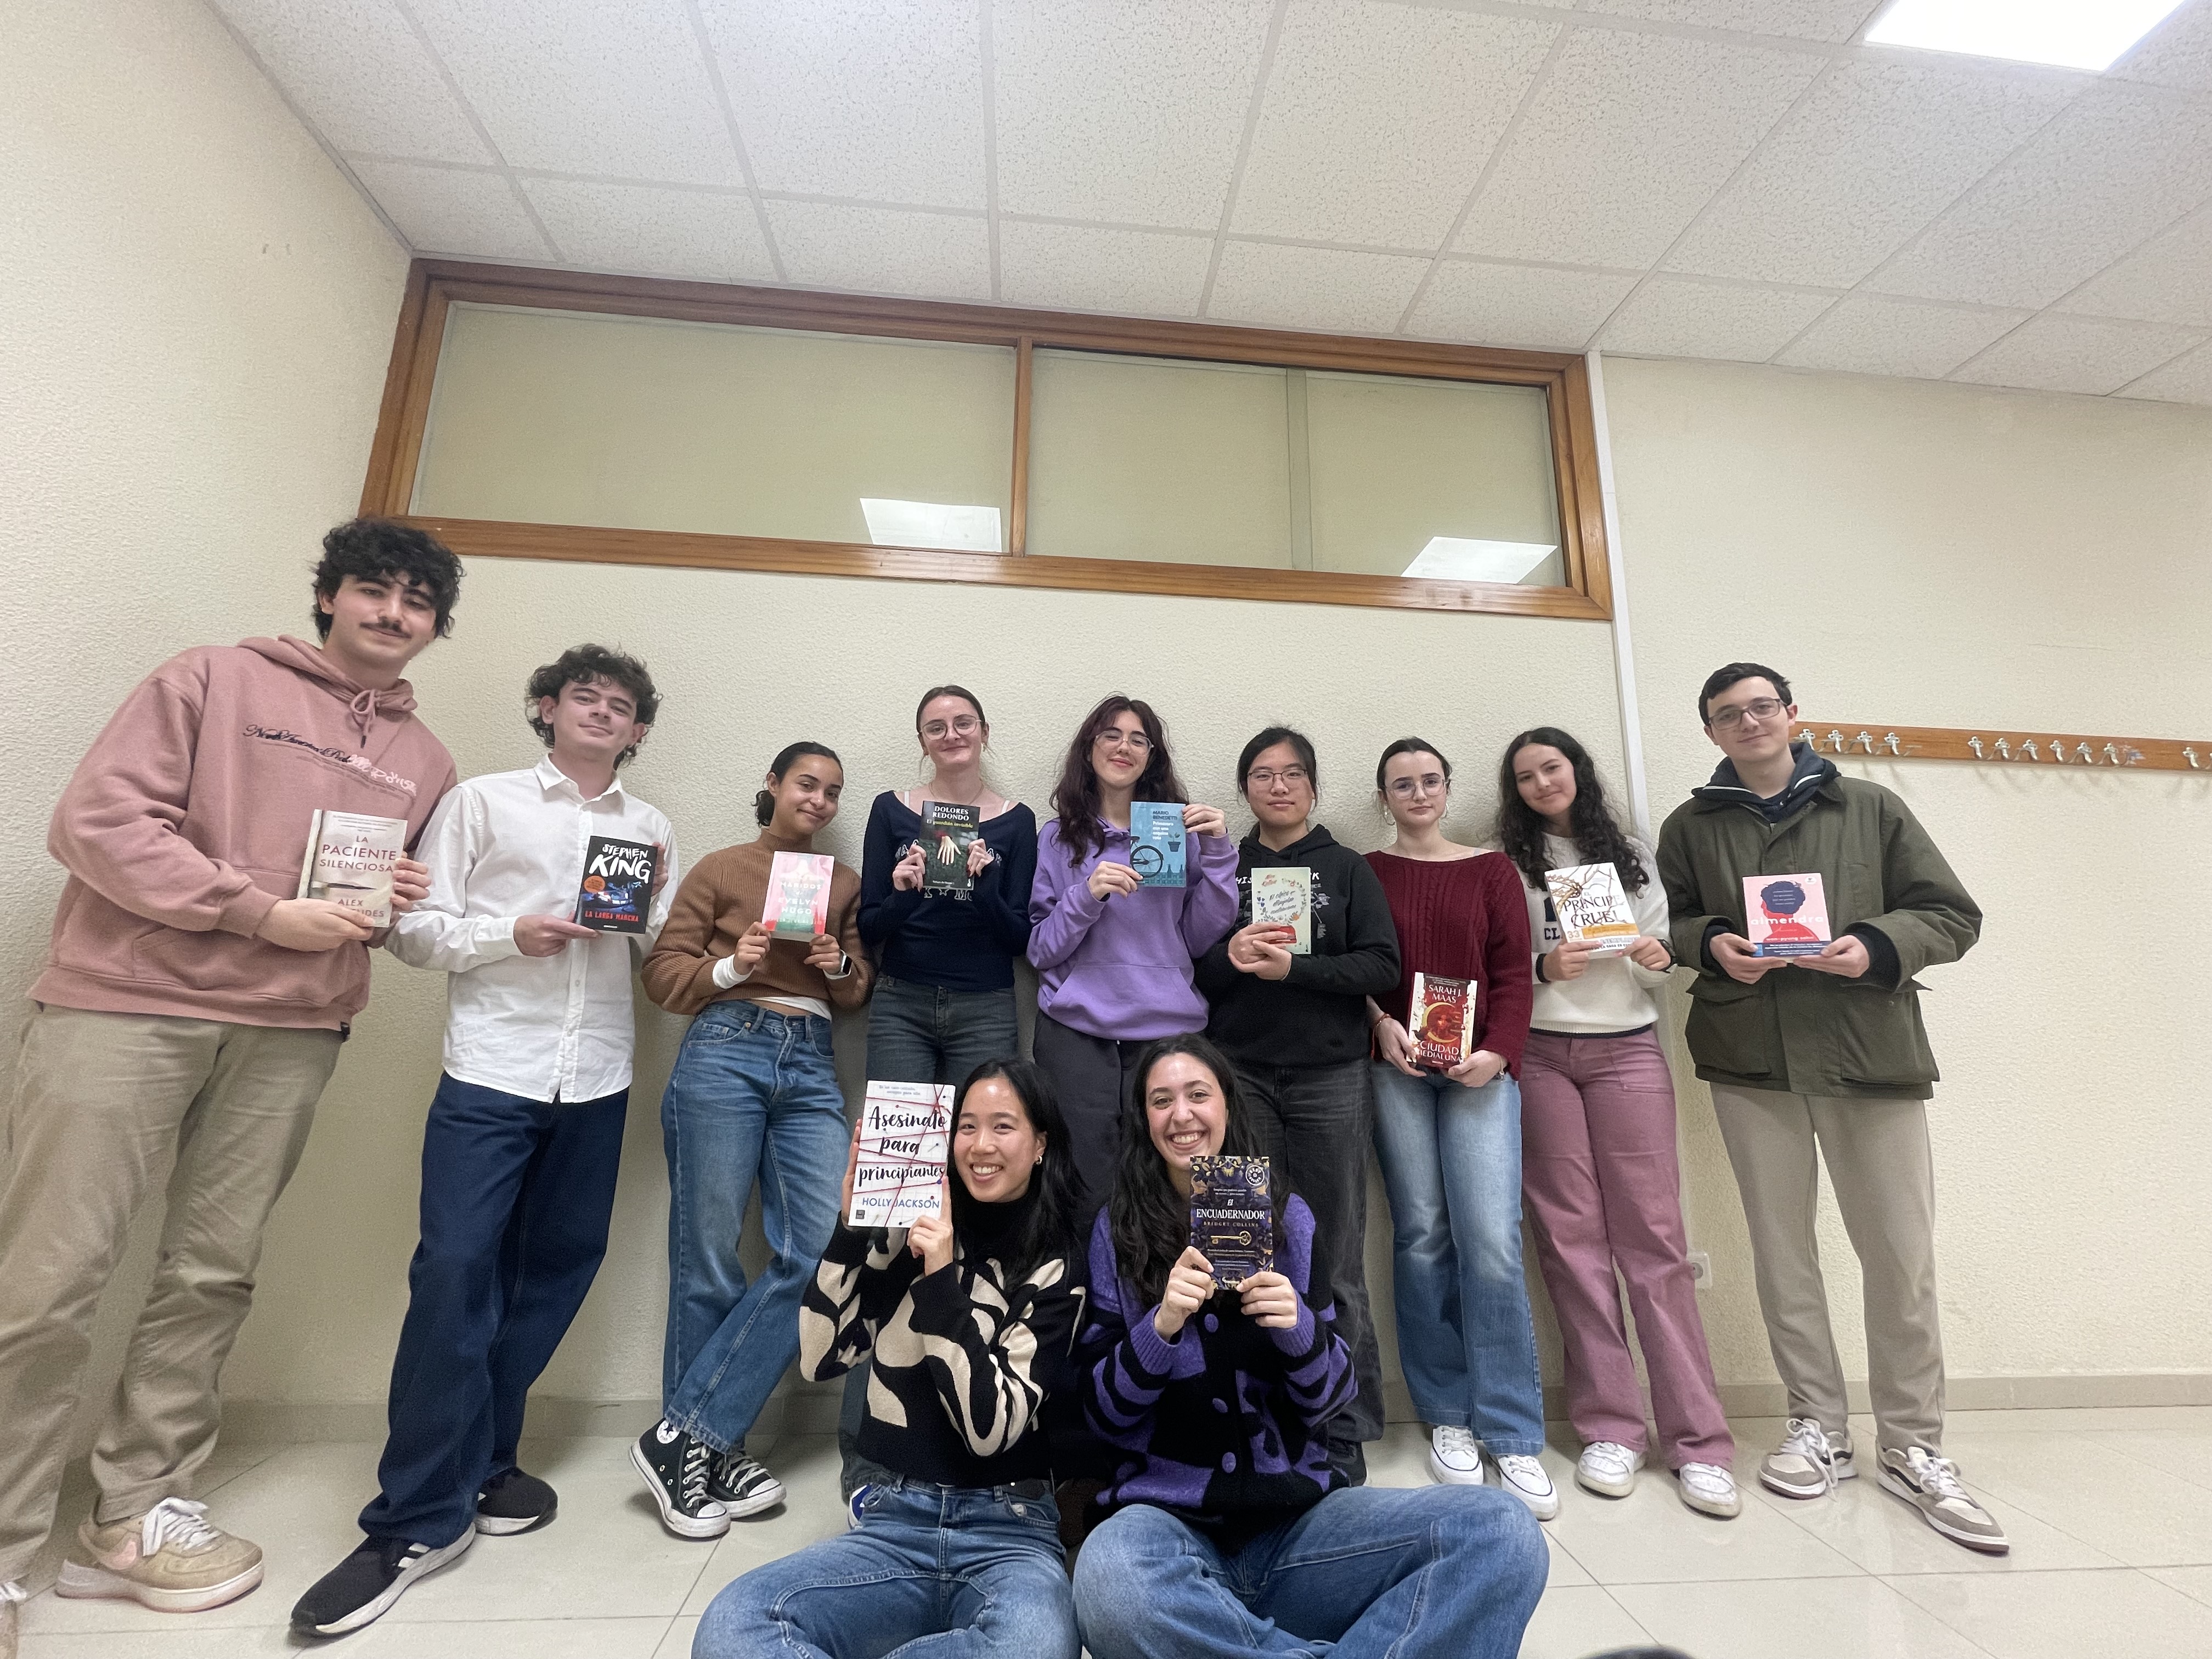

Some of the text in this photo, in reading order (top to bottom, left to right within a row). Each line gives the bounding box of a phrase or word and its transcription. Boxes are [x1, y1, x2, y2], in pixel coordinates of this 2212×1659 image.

[933, 811, 969, 821] REDONDO
[934, 805, 969, 815] DOLORES
[322, 844, 397, 860] PACIENTE
[602, 844, 648, 860] STEPHEN
[319, 859, 393, 872] SILENCIOSA
[588, 854, 652, 884] KING
[778, 897, 818, 905] EVELYN
[1571, 910, 1624, 927] CRUEL
[1751, 915, 1824, 926] almendra
[1544, 928, 1562, 940] CL
[1429, 984, 1456, 996] SARAH
[1432, 993, 1457, 1003] MAAS
[1420, 1040, 1459, 1055] CIUDAD
[868, 1105, 947, 1130] Asesinato
[879, 1136, 920, 1156] para
[859, 1164, 944, 1187] principiantes
[862, 1198, 940, 1209] HOLLY JACKSON
[1196, 1209, 1266, 1220] ENCUADERNADOR
